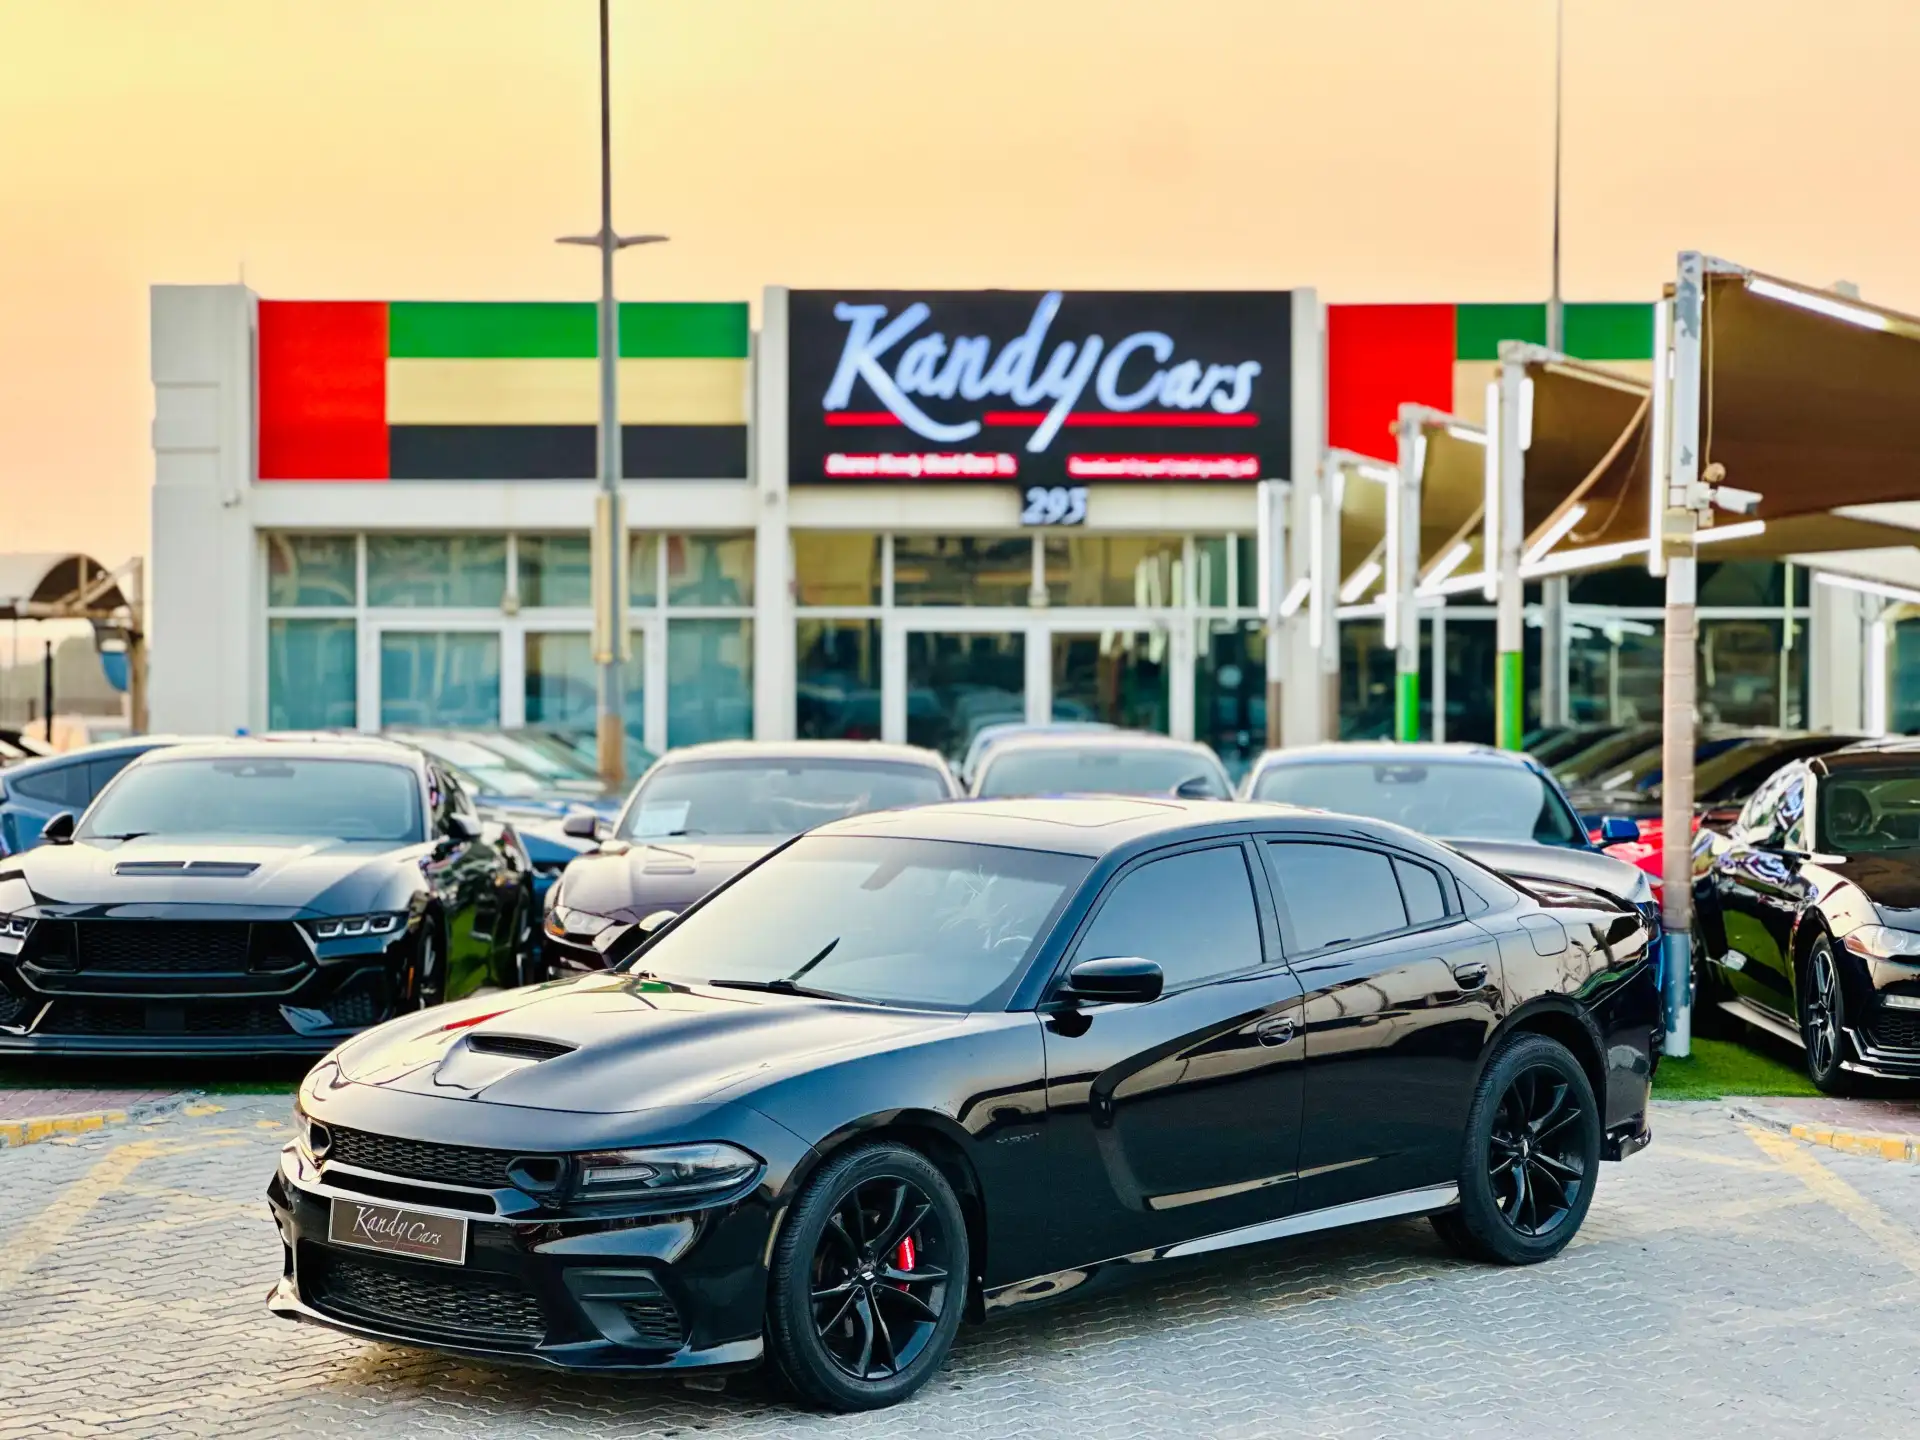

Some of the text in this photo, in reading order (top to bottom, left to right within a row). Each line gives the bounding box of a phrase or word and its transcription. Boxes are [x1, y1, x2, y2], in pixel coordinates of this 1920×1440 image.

[823, 291, 1261, 452] Kandy Cars
[1021, 486, 1089, 524] 295
[352, 1206, 442, 1250] Kandy Cars
